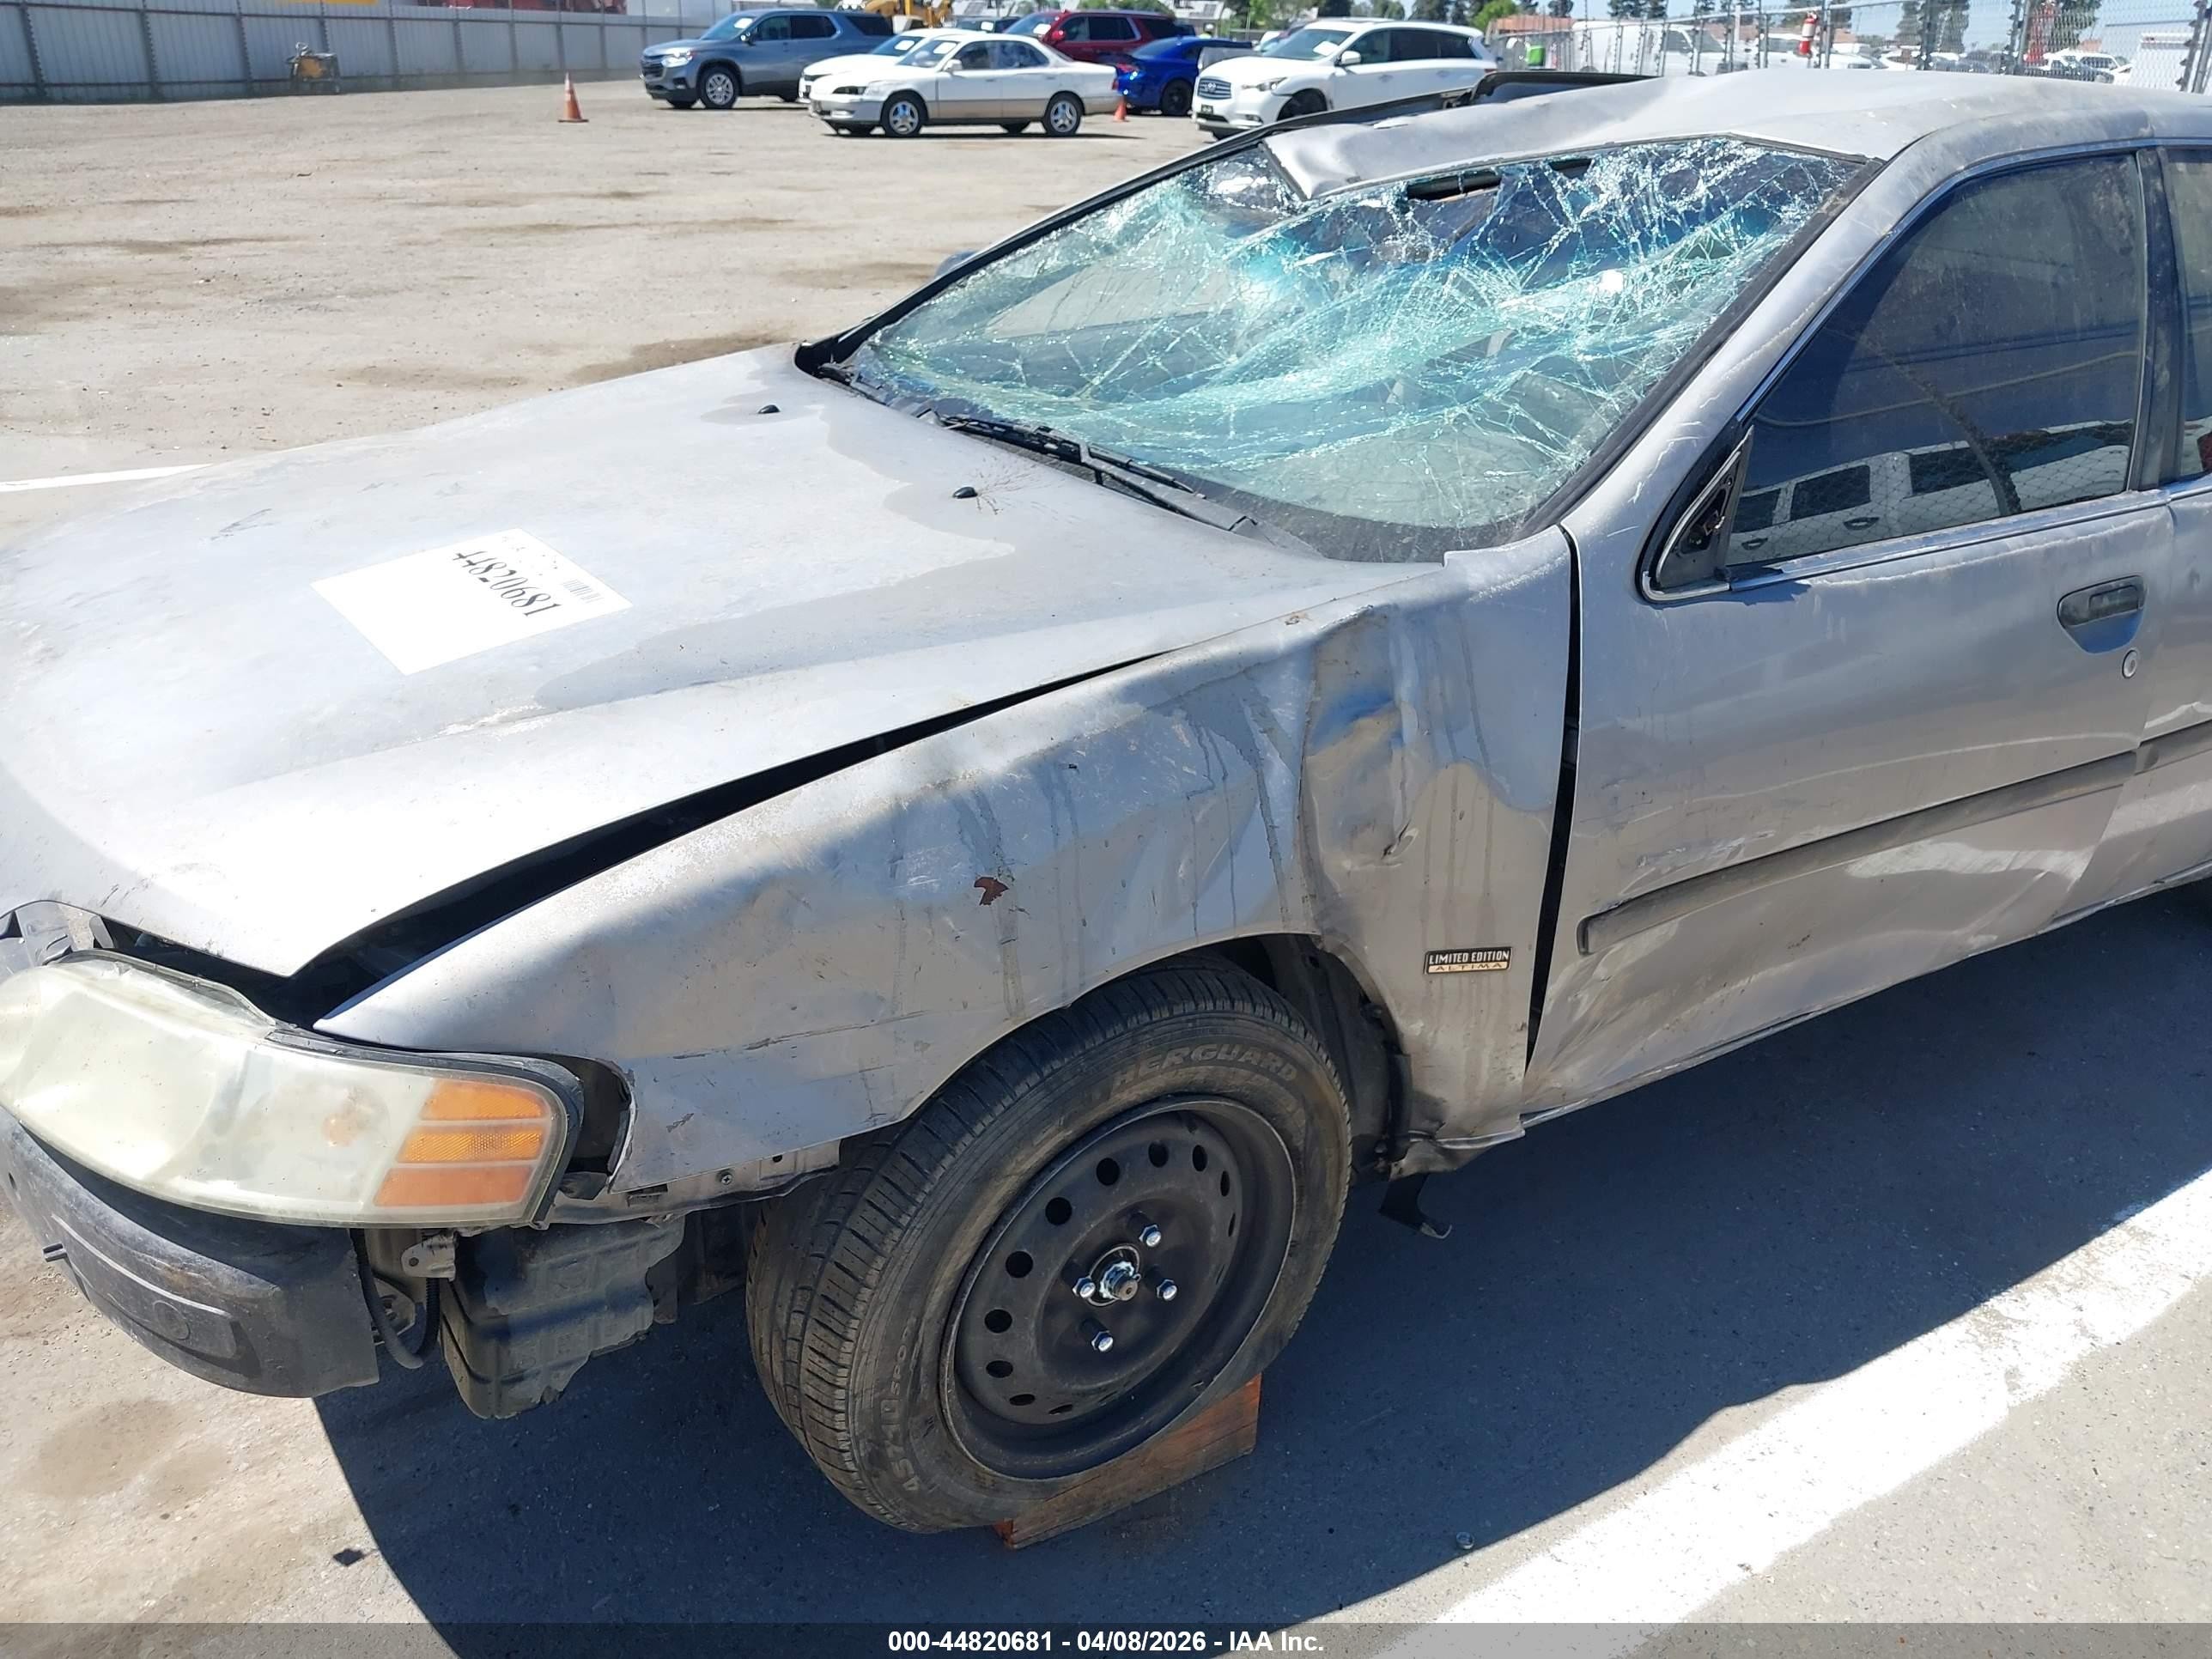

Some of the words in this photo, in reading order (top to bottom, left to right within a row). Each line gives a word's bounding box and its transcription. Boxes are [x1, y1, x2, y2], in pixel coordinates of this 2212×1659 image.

[452, 550, 562, 617] 44820681
[1429, 952, 1468, 964] LIMITED
[1471, 951, 1510, 962] EDITION
[1436, 963, 1502, 971] ALTIMA
